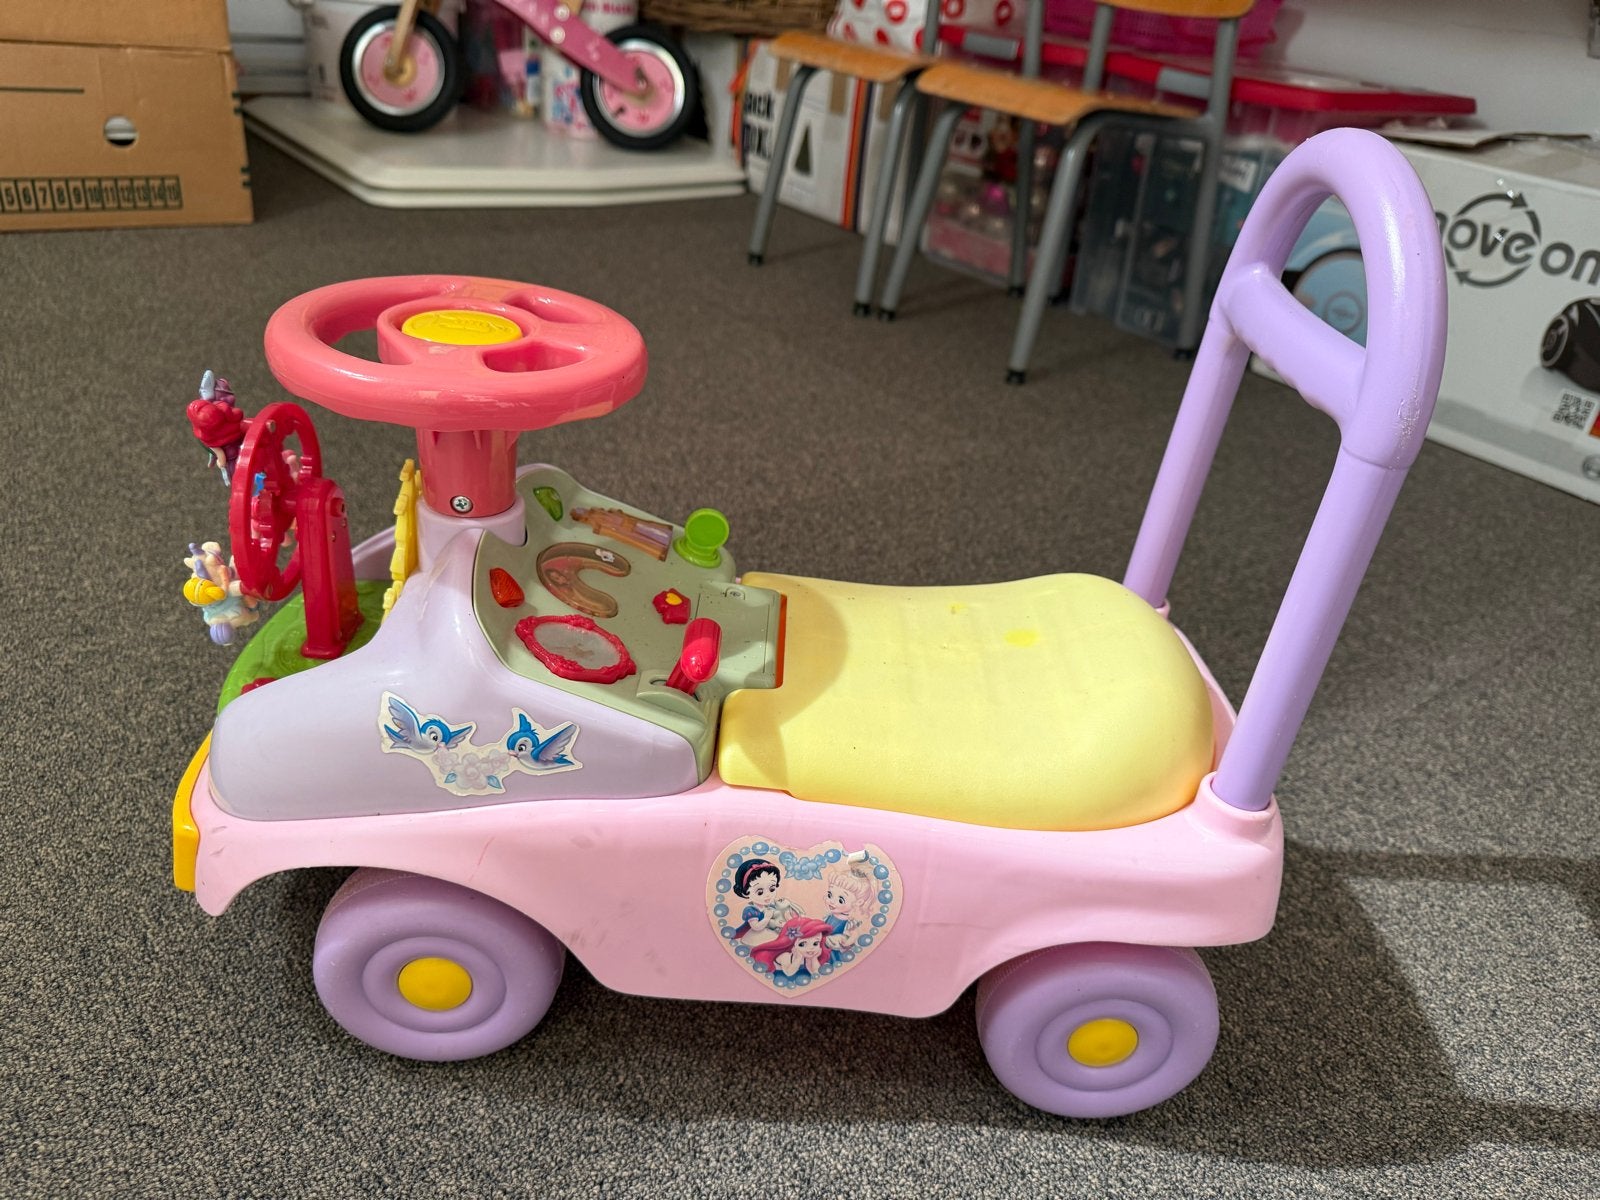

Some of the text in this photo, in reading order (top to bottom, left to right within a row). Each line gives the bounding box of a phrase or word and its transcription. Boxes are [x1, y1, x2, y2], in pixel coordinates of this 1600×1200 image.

[4, 187, 15, 206] 5
[38, 187, 48, 206] 7
[1540, 242, 1600, 286] on
